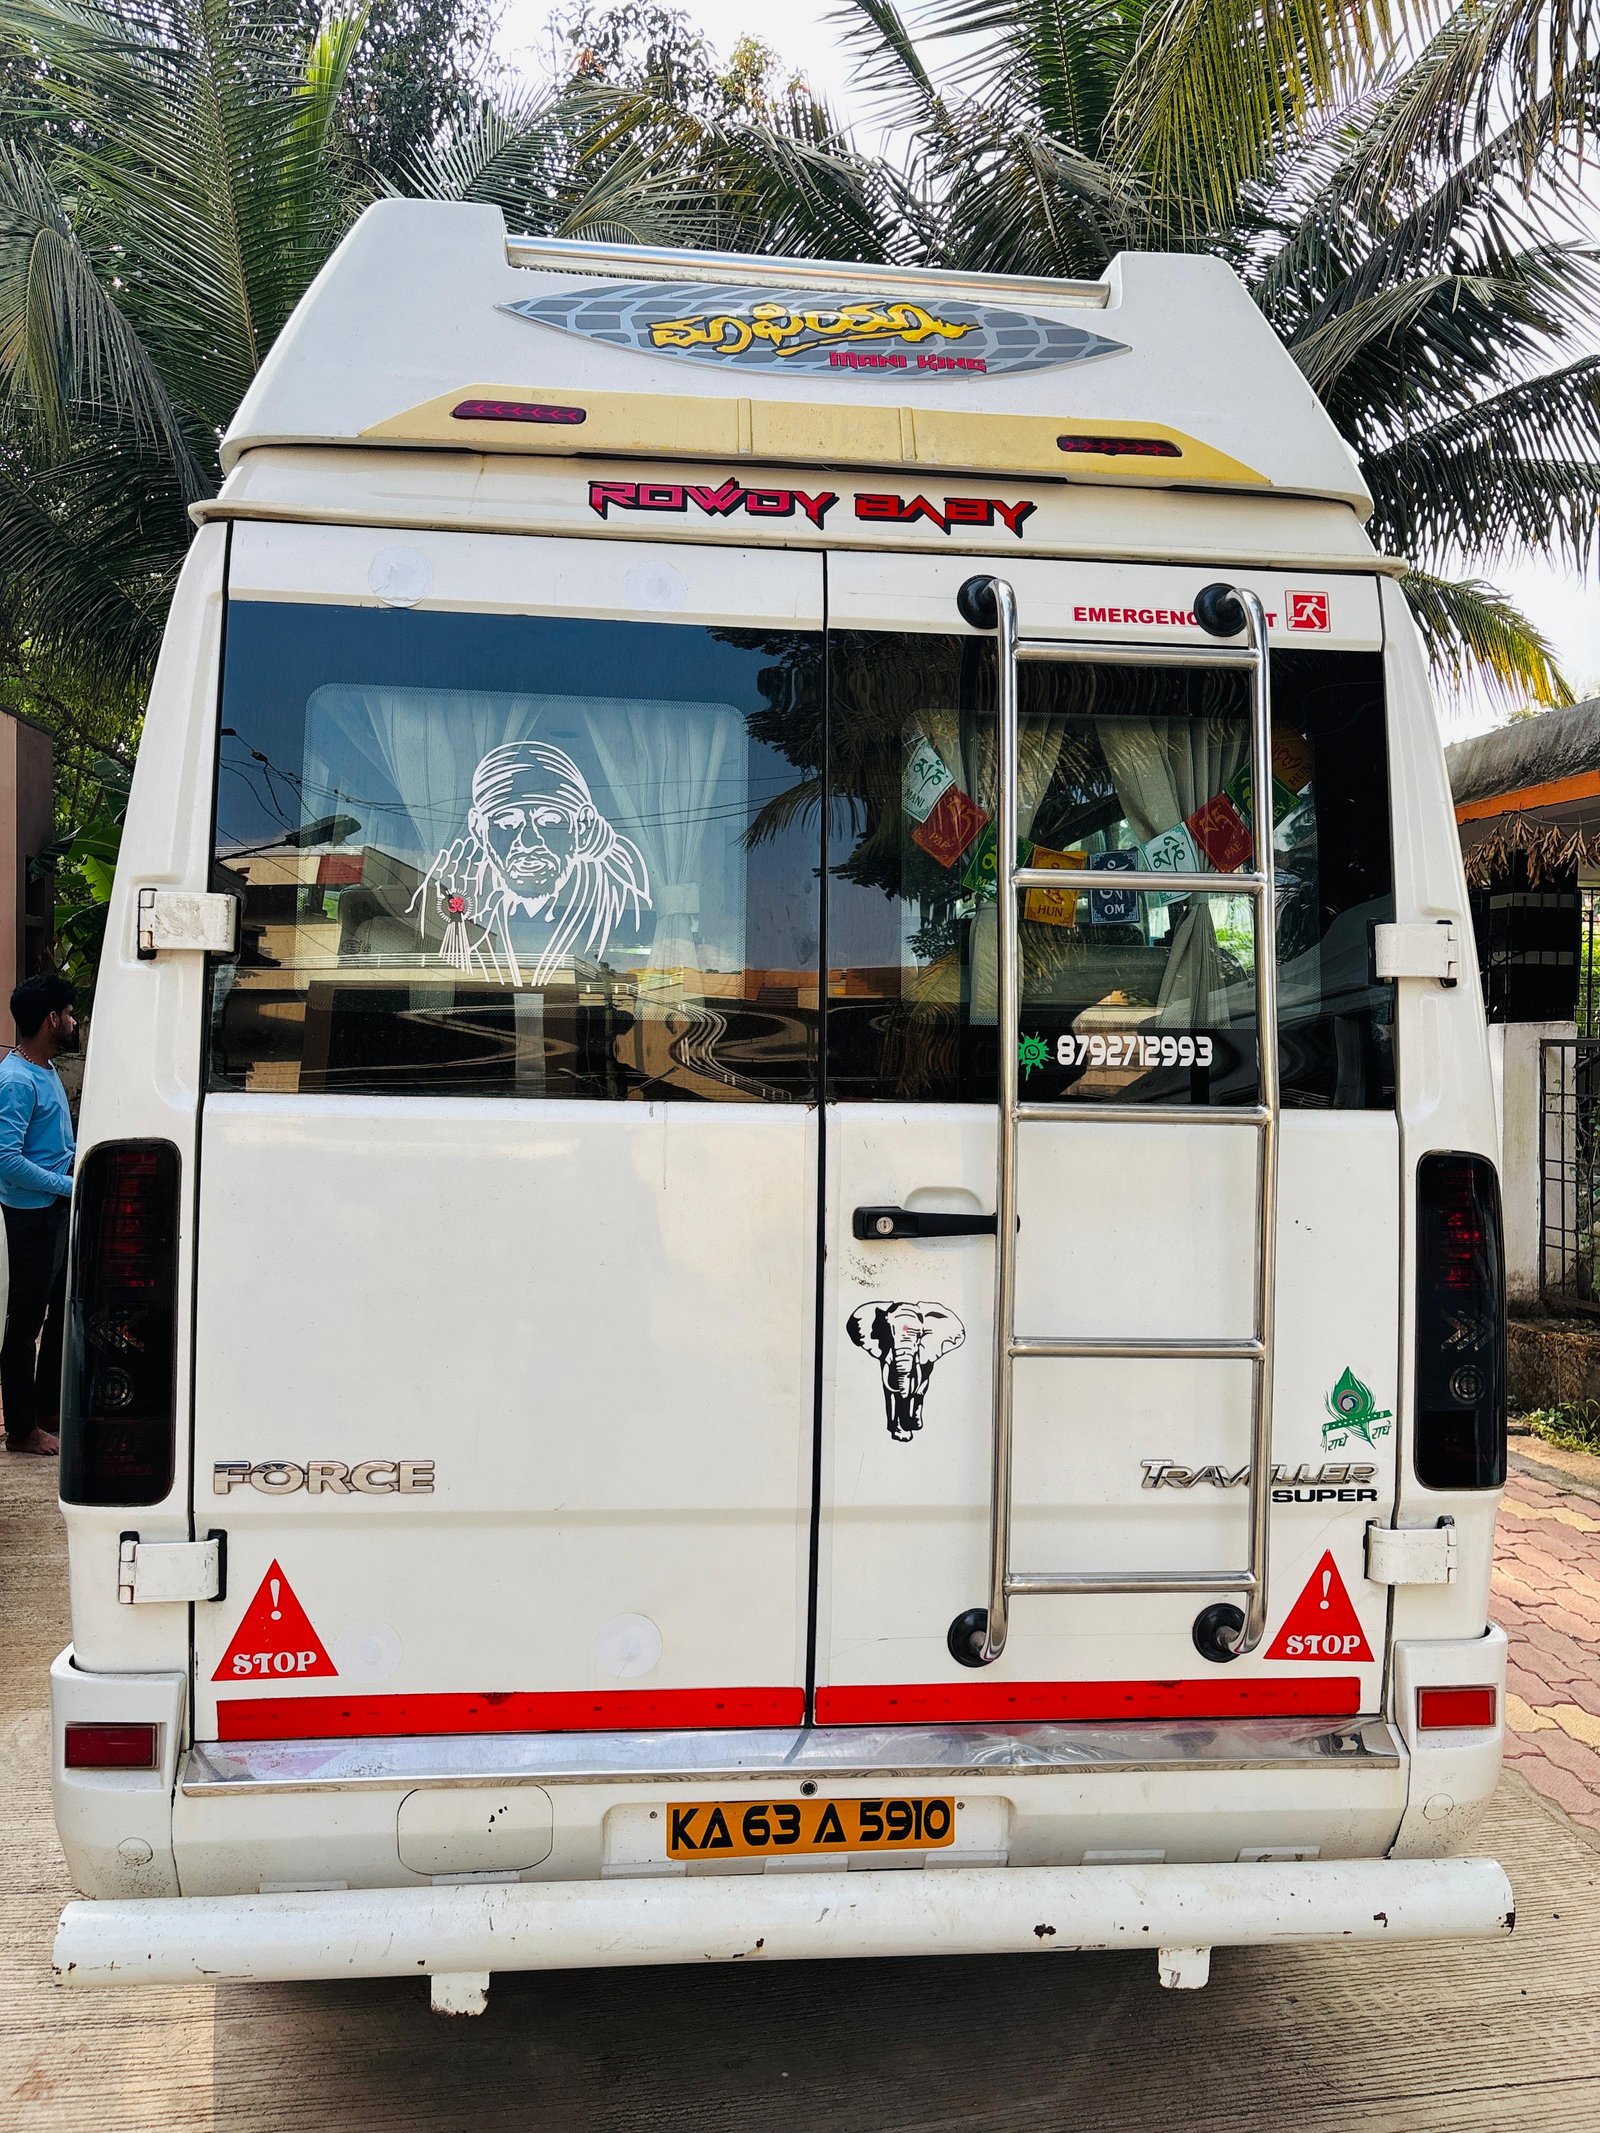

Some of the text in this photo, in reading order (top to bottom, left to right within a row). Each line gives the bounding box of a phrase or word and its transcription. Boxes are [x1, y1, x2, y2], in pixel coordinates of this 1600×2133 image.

[829, 351, 987, 373] MANI KING
[588, 477, 1038, 539] ROWDY BABY
[1073, 606, 1200, 626] EMERGENC
[1037, 904, 1064, 918] HUN
[1104, 904, 1125, 915] OM
[1057, 1034, 1213, 1067] 8792712993
[213, 1460, 436, 1495] FORCE
[1140, 1459, 1379, 1489] TRAVLLER
[1272, 1488, 1378, 1503] SUPER
[1286, 1635, 1361, 1656] STOP
[232, 1651, 317, 1675] STOP
[671, 1799, 951, 1850] KA 63 A 5910
